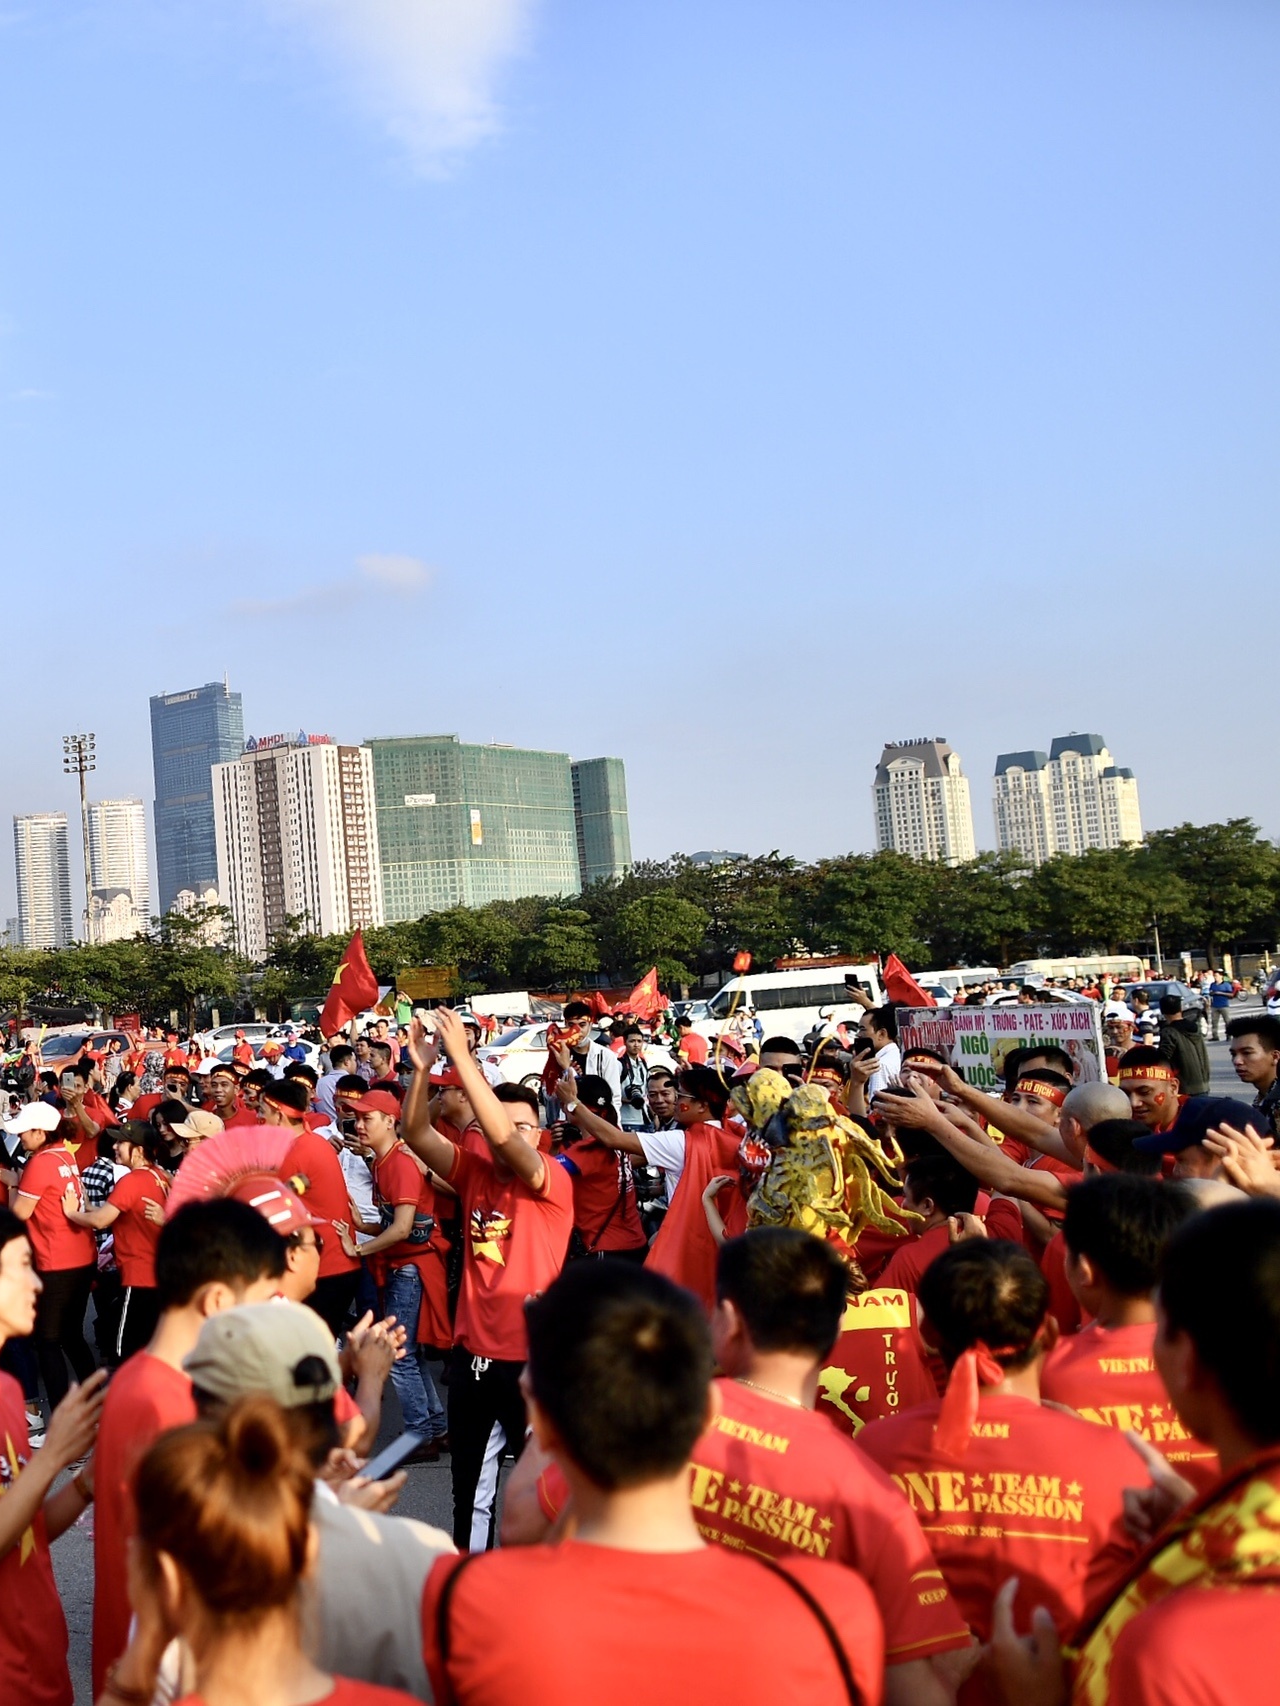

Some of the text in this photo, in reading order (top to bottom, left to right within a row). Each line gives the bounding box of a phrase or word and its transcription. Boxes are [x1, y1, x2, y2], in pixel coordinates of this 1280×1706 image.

[1024, 1014, 1044, 1031] PATE
[1051, 1010, 1068, 1030] XÚC
[1070, 1010, 1090, 1030] XÍCH
[961, 1031, 989, 1055] NGÔ
[845, 1294, 904, 1308] NAM
[882, 1334, 899, 1415] TRƯỜ
[989, 1472, 1061, 1499] TEAM
[747, 1484, 817, 1530] TEAM
[971, 1492, 1084, 1523] PASSION
[722, 1497, 832, 1559] PASSION
[946, 1524, 1003, 1539] SINCE 2017
